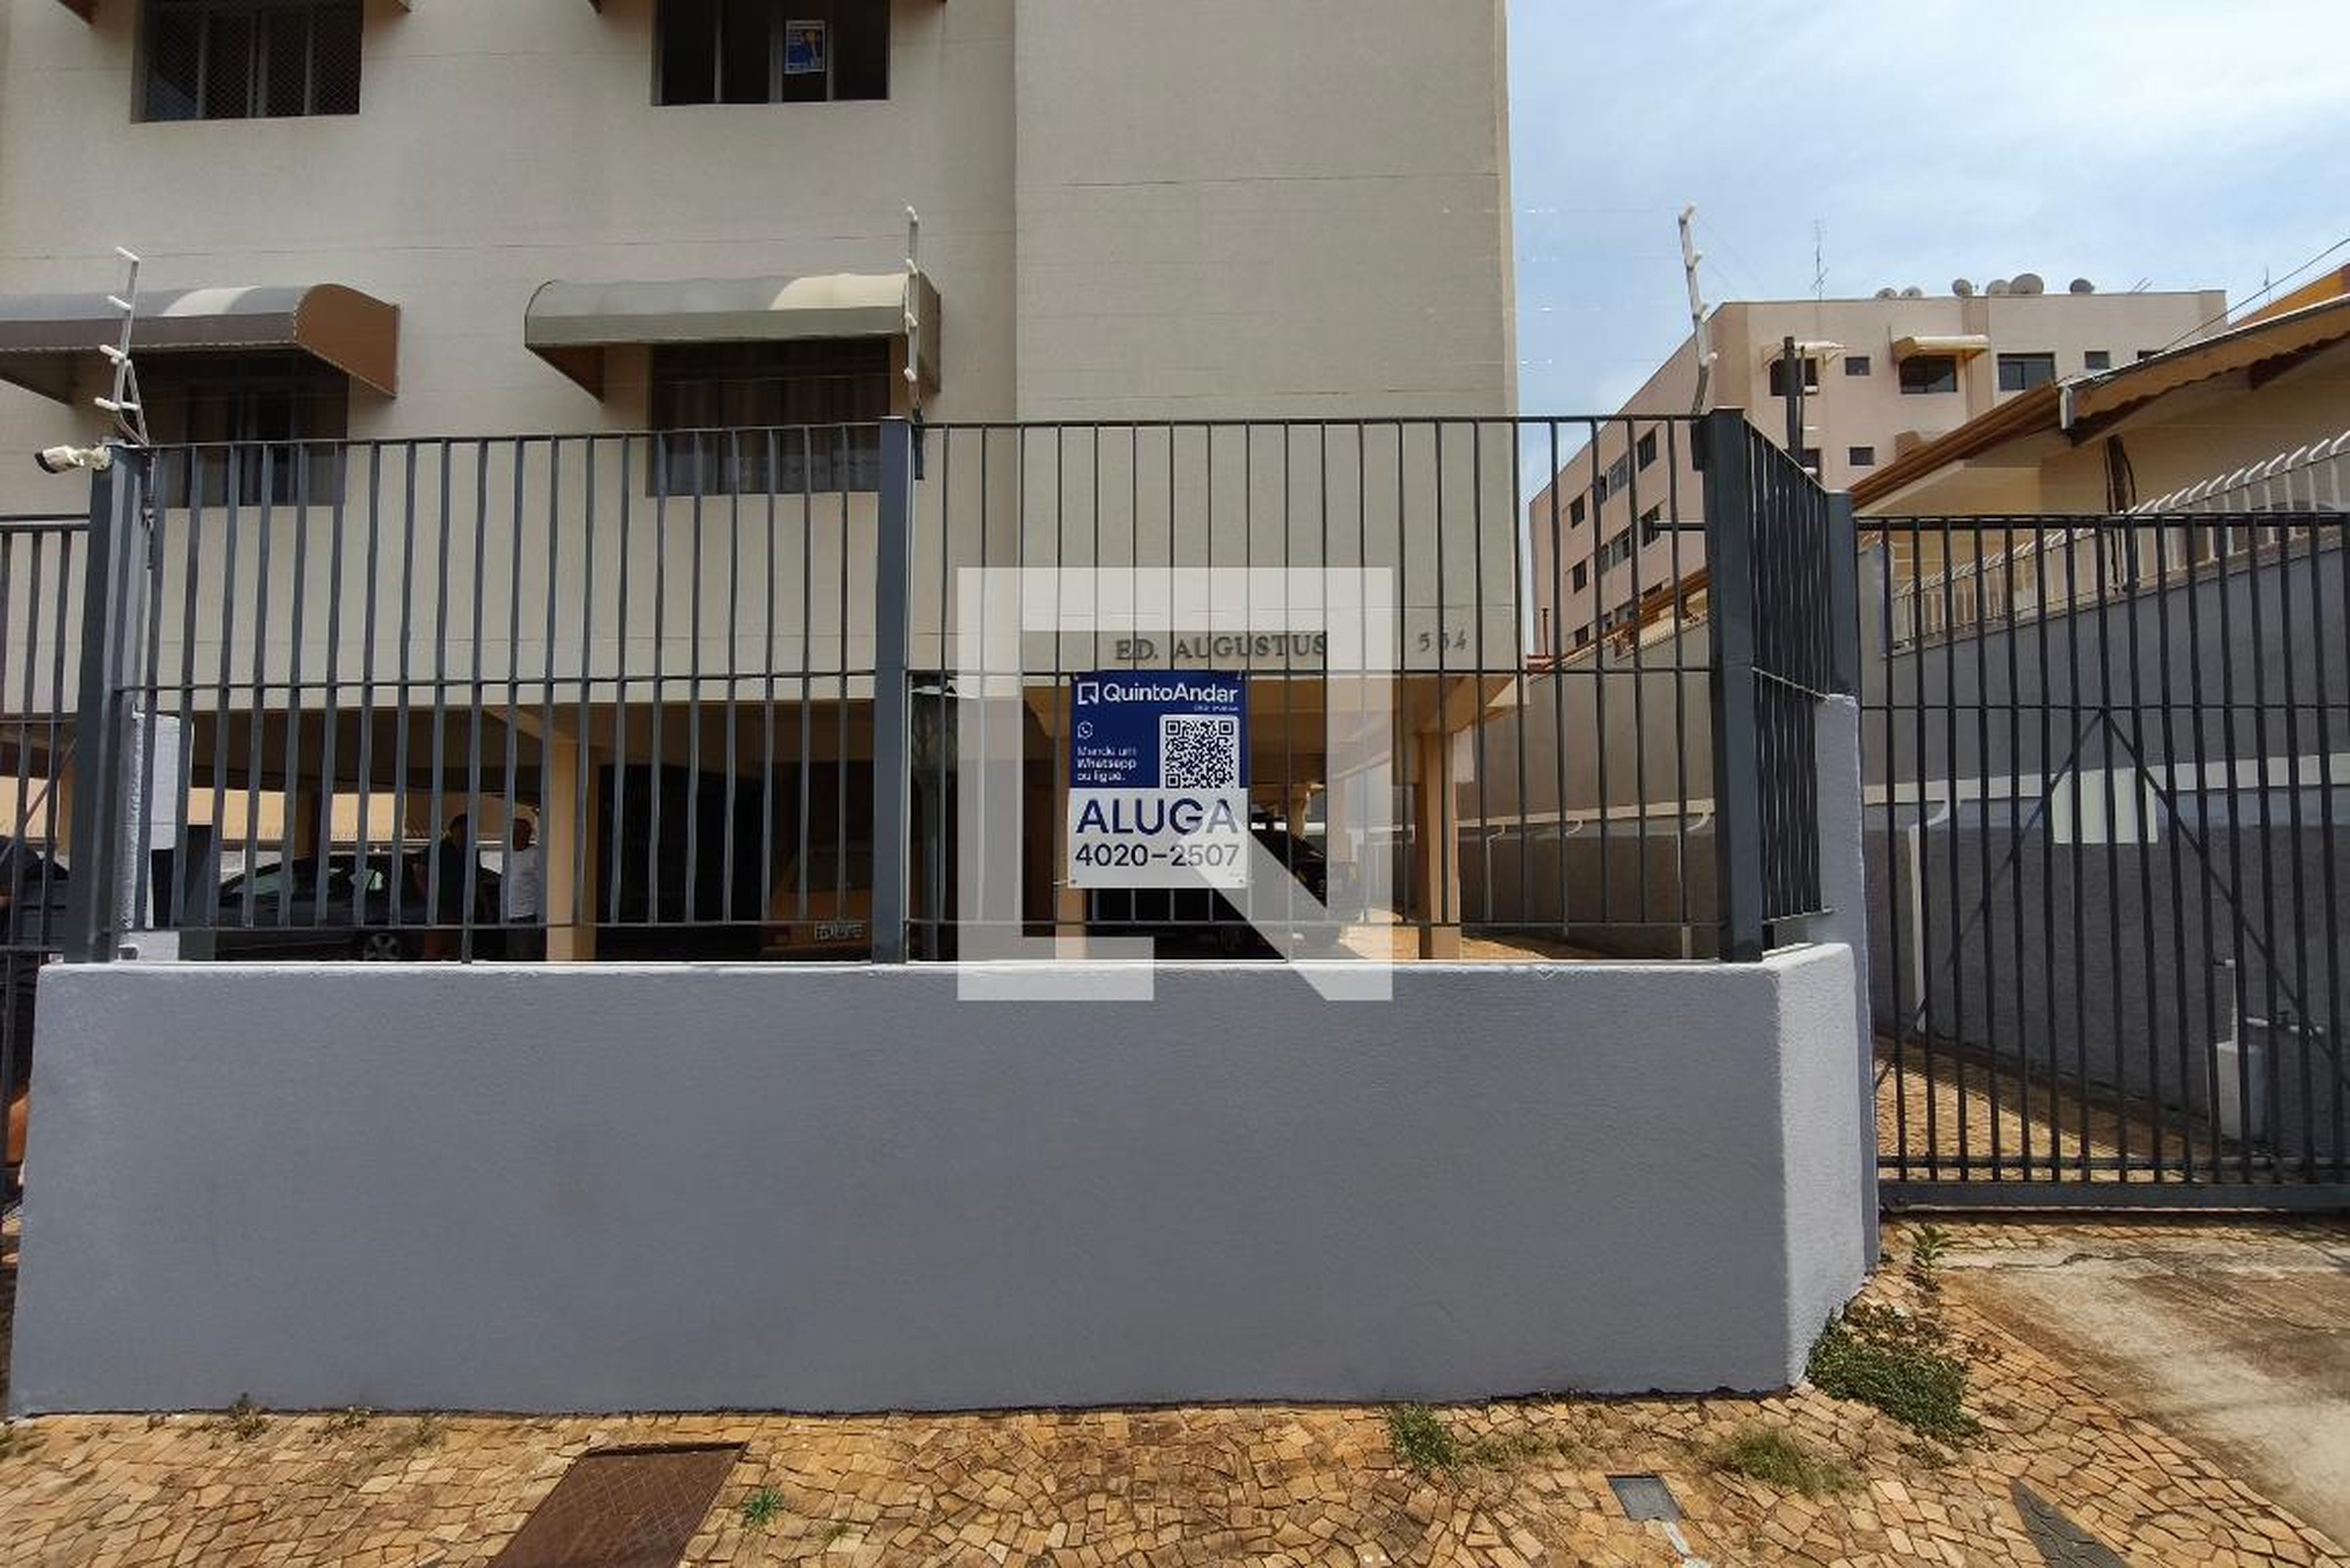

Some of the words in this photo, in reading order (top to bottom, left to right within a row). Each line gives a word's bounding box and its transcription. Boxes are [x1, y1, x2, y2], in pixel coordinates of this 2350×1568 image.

[1115, 639, 1158, 660] ED.
[1174, 634, 1327, 659] AUGUSTUS
[1103, 682, 1239, 703] QuintoAndar
[1076, 798, 1239, 835] ALUGA
[1075, 843, 1240, 867] 4020-2507
